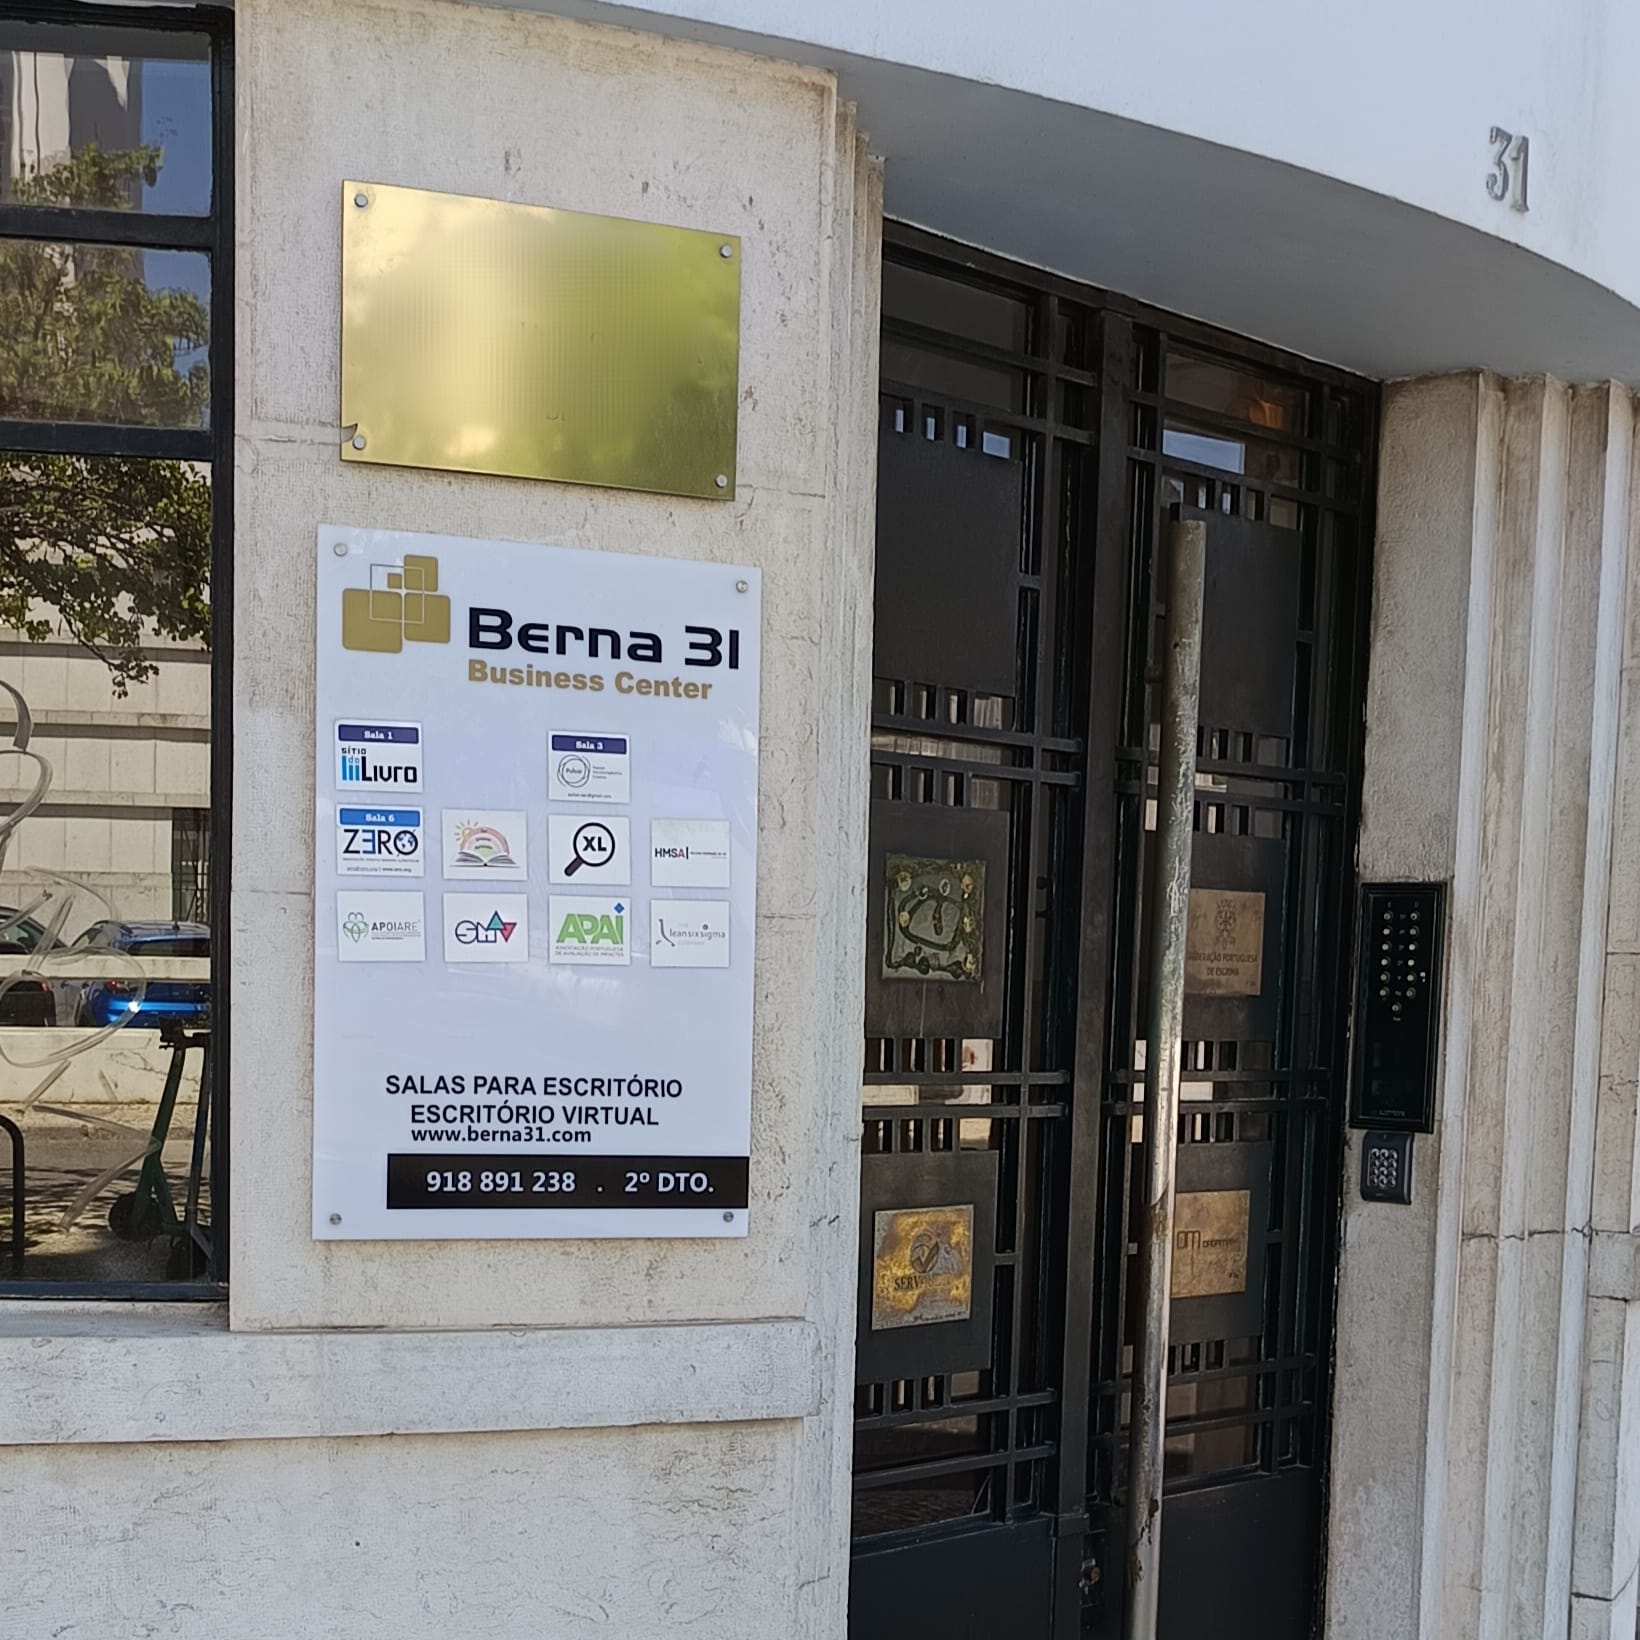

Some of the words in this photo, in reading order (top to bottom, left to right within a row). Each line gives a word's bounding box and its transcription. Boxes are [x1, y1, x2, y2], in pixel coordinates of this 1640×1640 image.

[1486, 126, 1529, 213] 31
[468, 607, 663, 664] Berna
[468, 659, 605, 692] Business
[614, 671, 713, 700] Center
[364, 730, 385, 740] Sala
[575, 740, 595, 750] Sala
[365, 813, 386, 822] Sala
[343, 828, 419, 857] ZERO
[582, 836, 607, 852] XL
[654, 847, 686, 859] HMSA
[371, 921, 418, 932] APOIARE
[556, 913, 624, 945] APAI
[385, 1075, 465, 1095] SALAS
[473, 1076, 536, 1096] PARA
[543, 1074, 683, 1098] ESCRITÓRIO
[411, 1100, 555, 1125] ESCRITÓRIO
[562, 1106, 659, 1126] VIRTUAL
[411, 1126, 592, 1143] www.berna31.com
[426, 1171, 472, 1192] 918
[479, 1171, 524, 1192] 891
[532, 1172, 576, 1192] 238
[657, 1173, 714, 1193] DTO.
